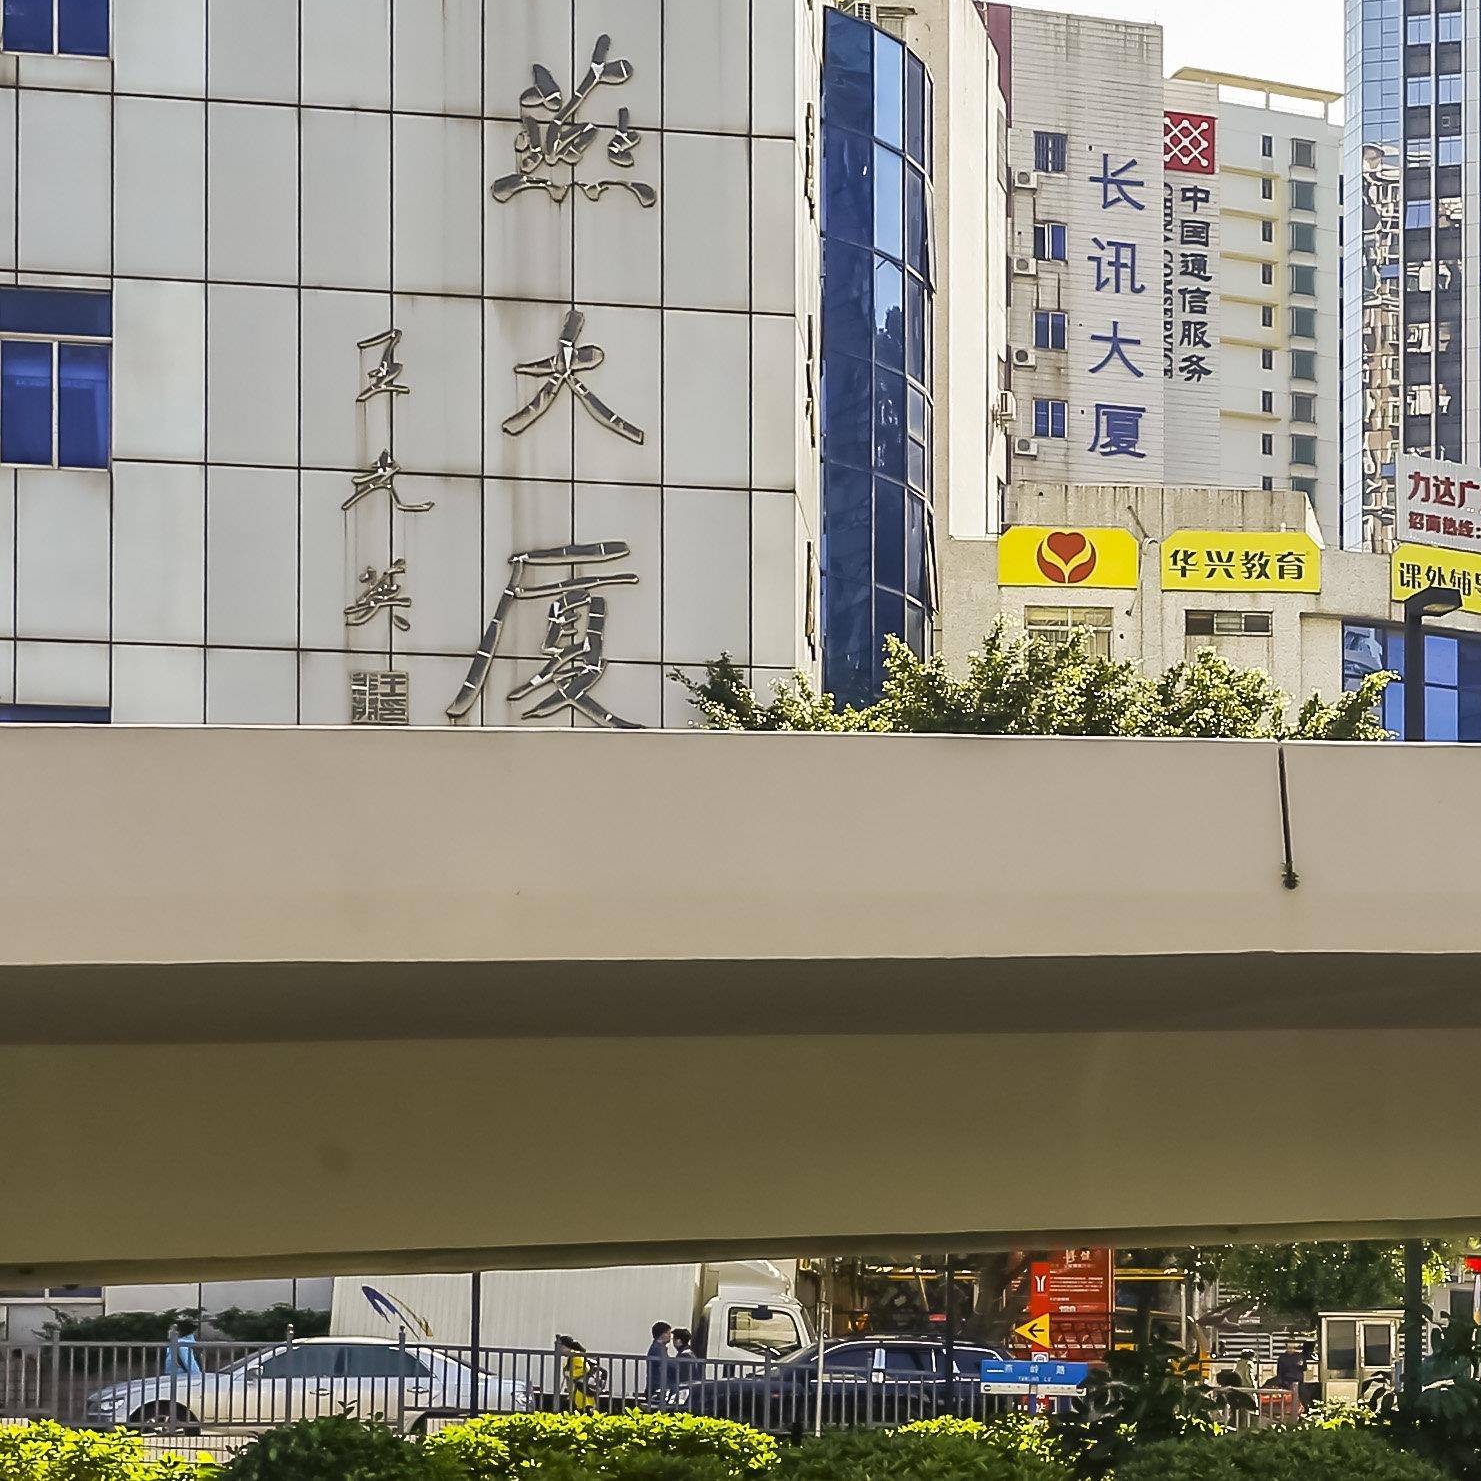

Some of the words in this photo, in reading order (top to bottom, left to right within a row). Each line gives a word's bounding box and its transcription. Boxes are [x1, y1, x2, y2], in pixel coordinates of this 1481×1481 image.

[1088, 153, 1147, 458] 长讯大厦
[1178, 185, 1212, 383] 中国通信服务
[1168, 549, 1306, 580] 华兴教育
